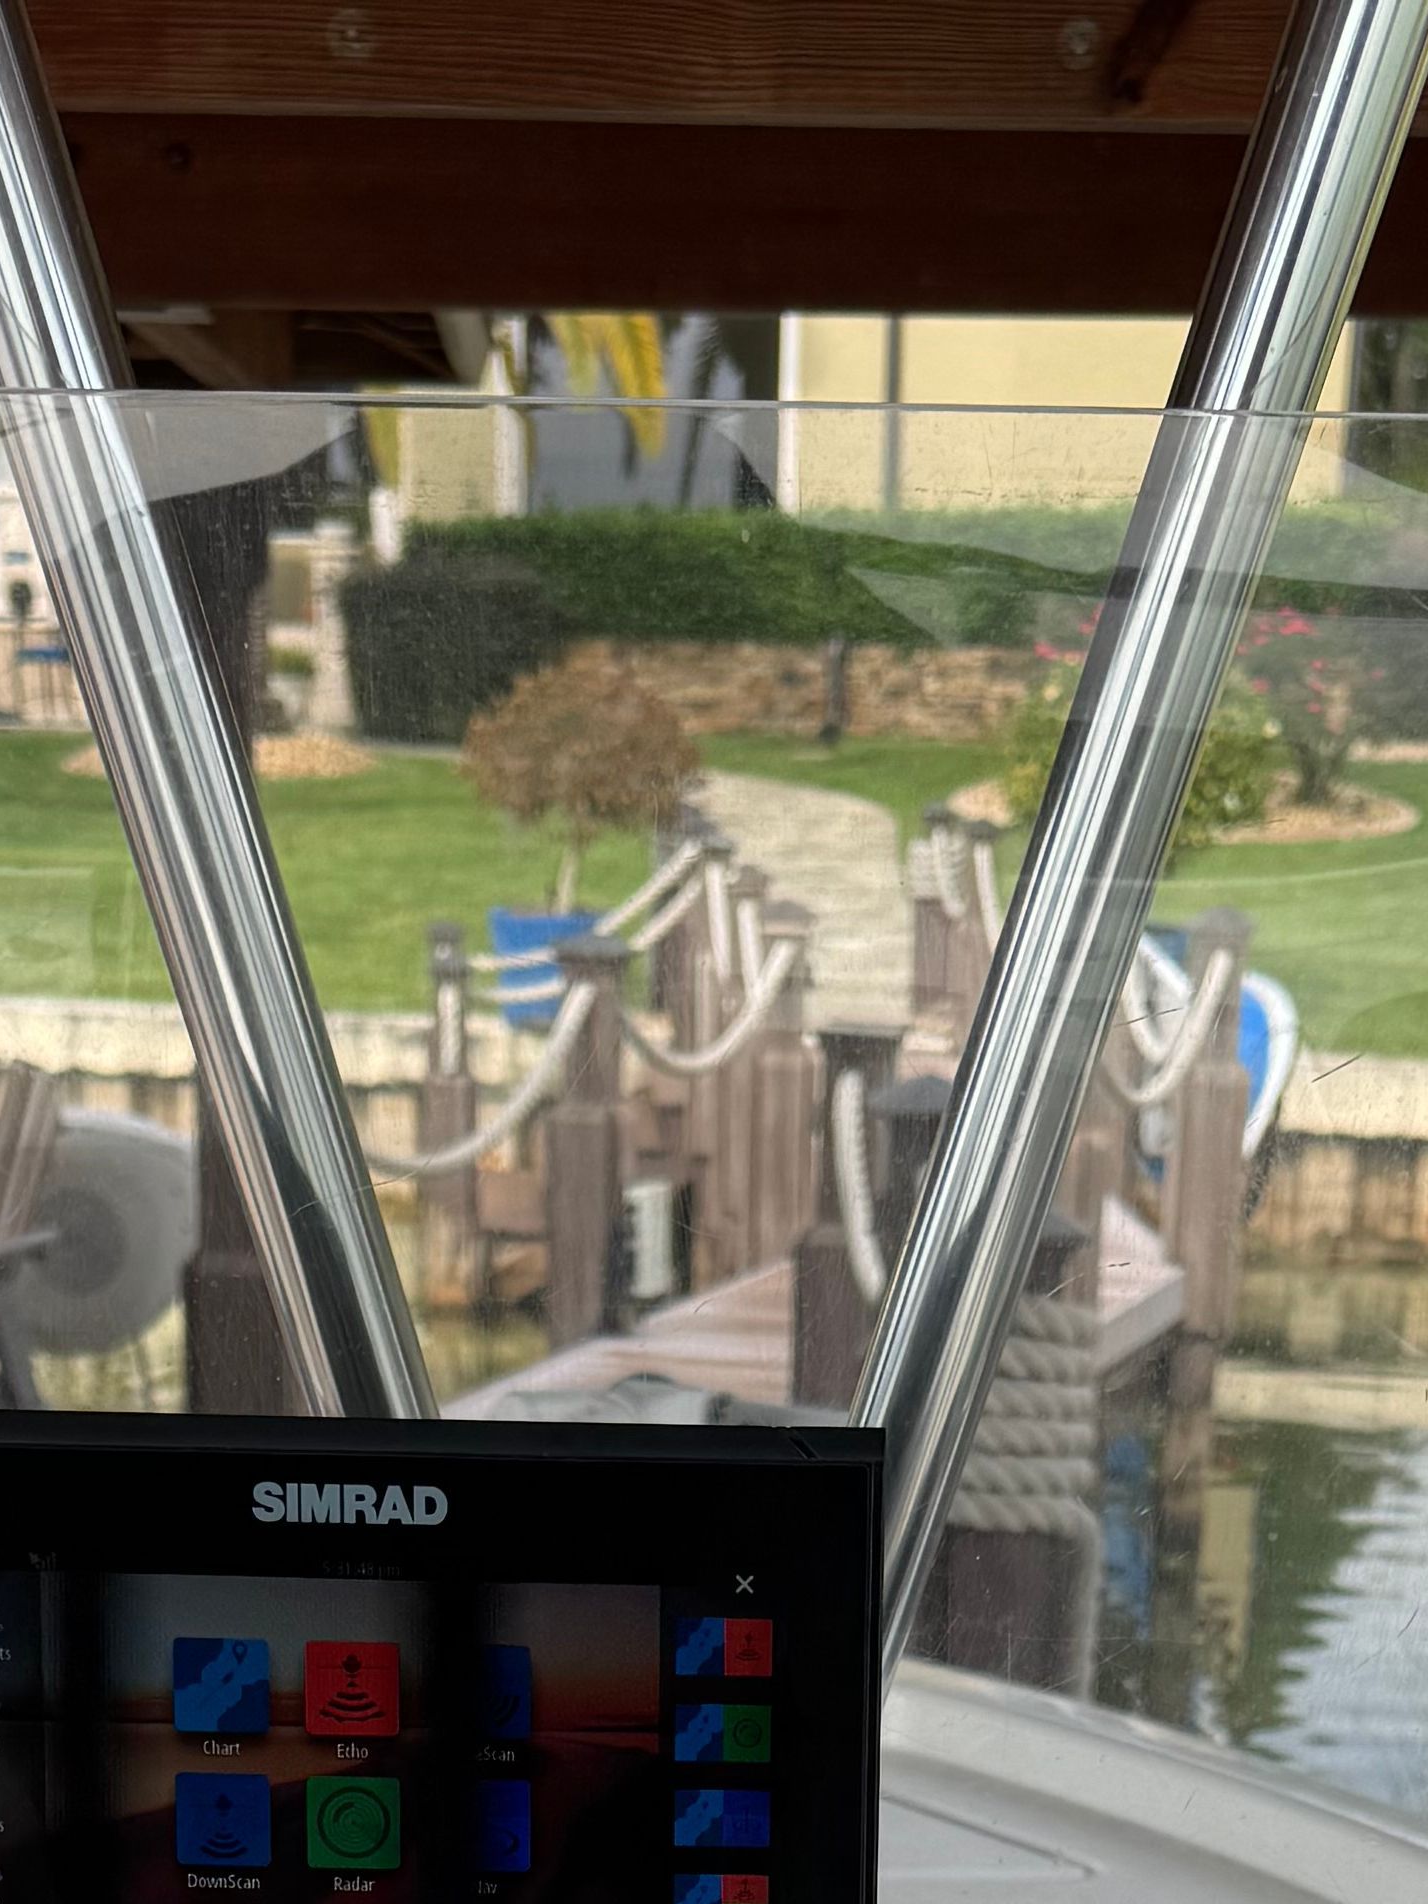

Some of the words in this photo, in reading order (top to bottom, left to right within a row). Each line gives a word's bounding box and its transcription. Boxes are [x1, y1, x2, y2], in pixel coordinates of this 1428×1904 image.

[252, 1481, 449, 1526] SIMRAD
[202, 1738, 241, 1757] Chart
[336, 1742, 370, 1761] Echo
[186, 1873, 262, 1891] DownScan
[333, 1876, 376, 1893] Radar
